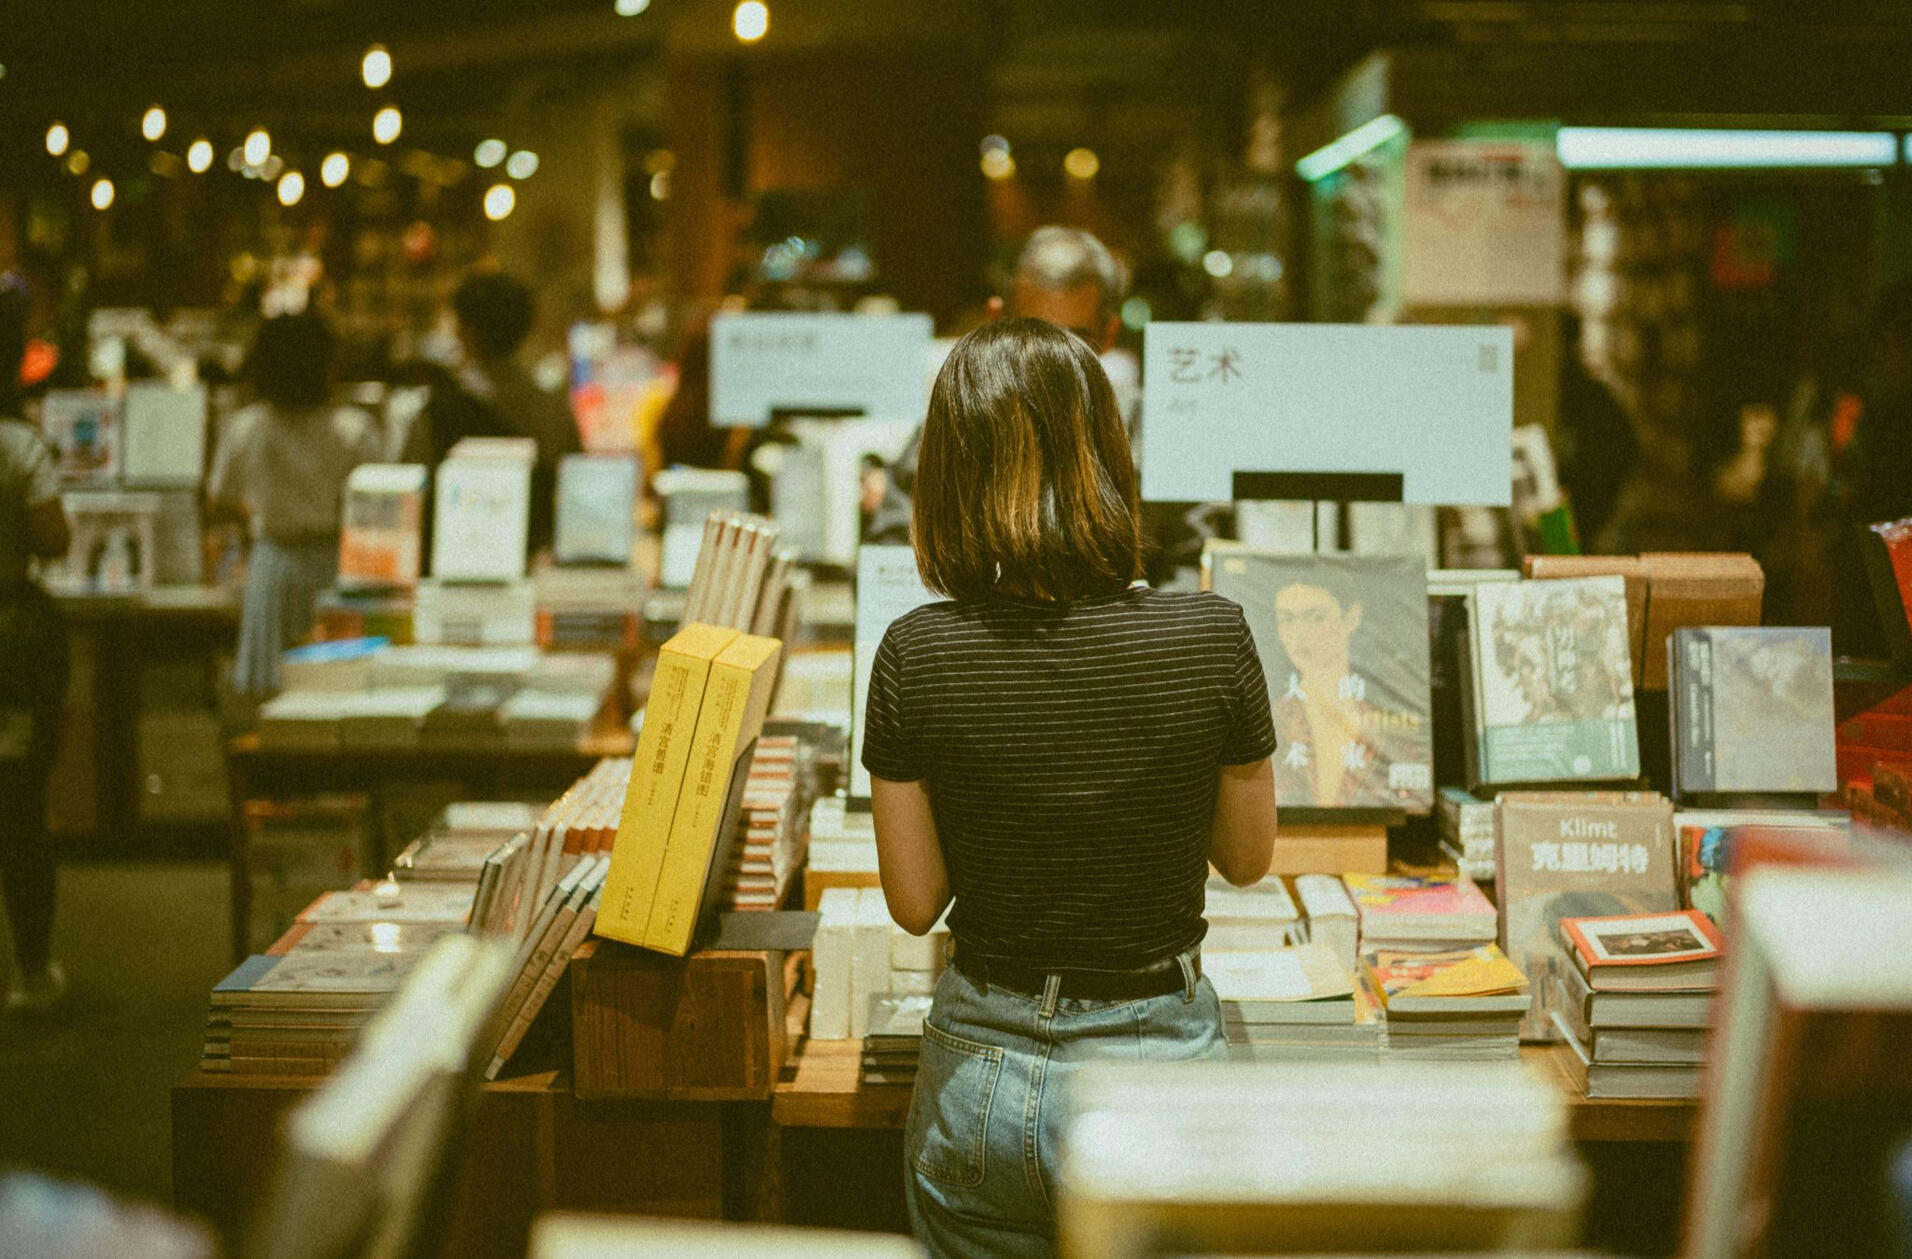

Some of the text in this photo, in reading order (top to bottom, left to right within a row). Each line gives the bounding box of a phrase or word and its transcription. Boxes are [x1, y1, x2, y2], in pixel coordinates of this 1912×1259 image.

[1168, 346, 1242, 385] 艺术
[1559, 817, 1617, 839] Klimt
[1531, 840, 1649, 874] 克里姆特
